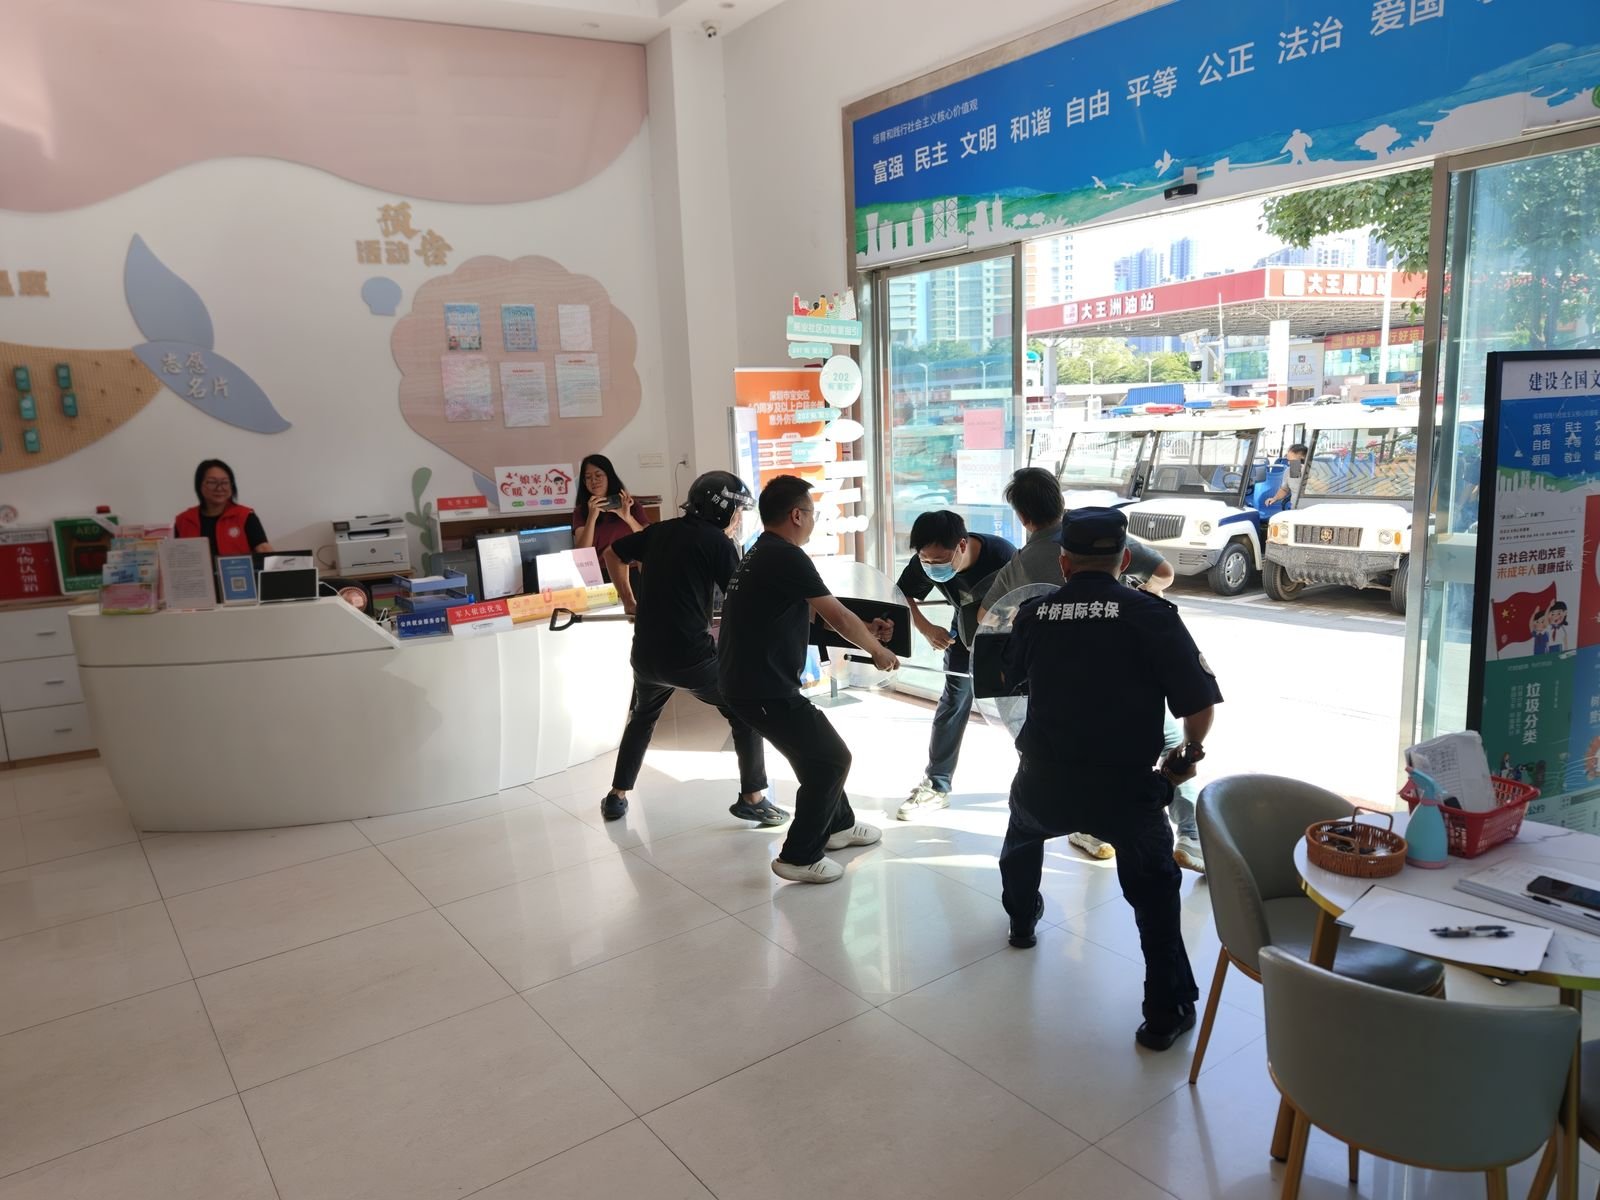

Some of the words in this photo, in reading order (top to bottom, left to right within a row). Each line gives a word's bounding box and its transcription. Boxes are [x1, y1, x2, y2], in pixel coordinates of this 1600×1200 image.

[872, 154, 904, 185] 富强
[915, 141, 948, 172] 民主
[960, 124, 997, 159] 文明
[1010, 106, 1051, 144] 和谐
[1066, 89, 1109, 128] 自由
[1126, 66, 1178, 107] 平等
[1198, 41, 1255, 86] 公正
[1278, 15, 1344, 64] 法治
[1370, 0, 1444, 36] 爱国
[1081, 291, 1154, 321] 大王洲油站
[1346, 334, 1377, 347] 加好油
[161, 351, 208, 375] 志愿
[186, 376, 229, 399] 名片
[1532, 423, 1551, 435] 富强
[1565, 421, 1582, 433] 民主
[1532, 439, 1551, 451] 自由
[1531, 454, 1550, 466] 爱国
[1564, 452, 1582, 464] 敬业
[519, 473, 553, 485] 娘家人
[512, 485, 553, 497] 暖心角
[1498, 546, 1566, 565] 全社会关心关爱
[1496, 560, 1574, 579] 未成年人健康成长
[1036, 600, 1120, 621] 中侨国际安保
[1522, 681, 1541, 745] 垃圾分类
